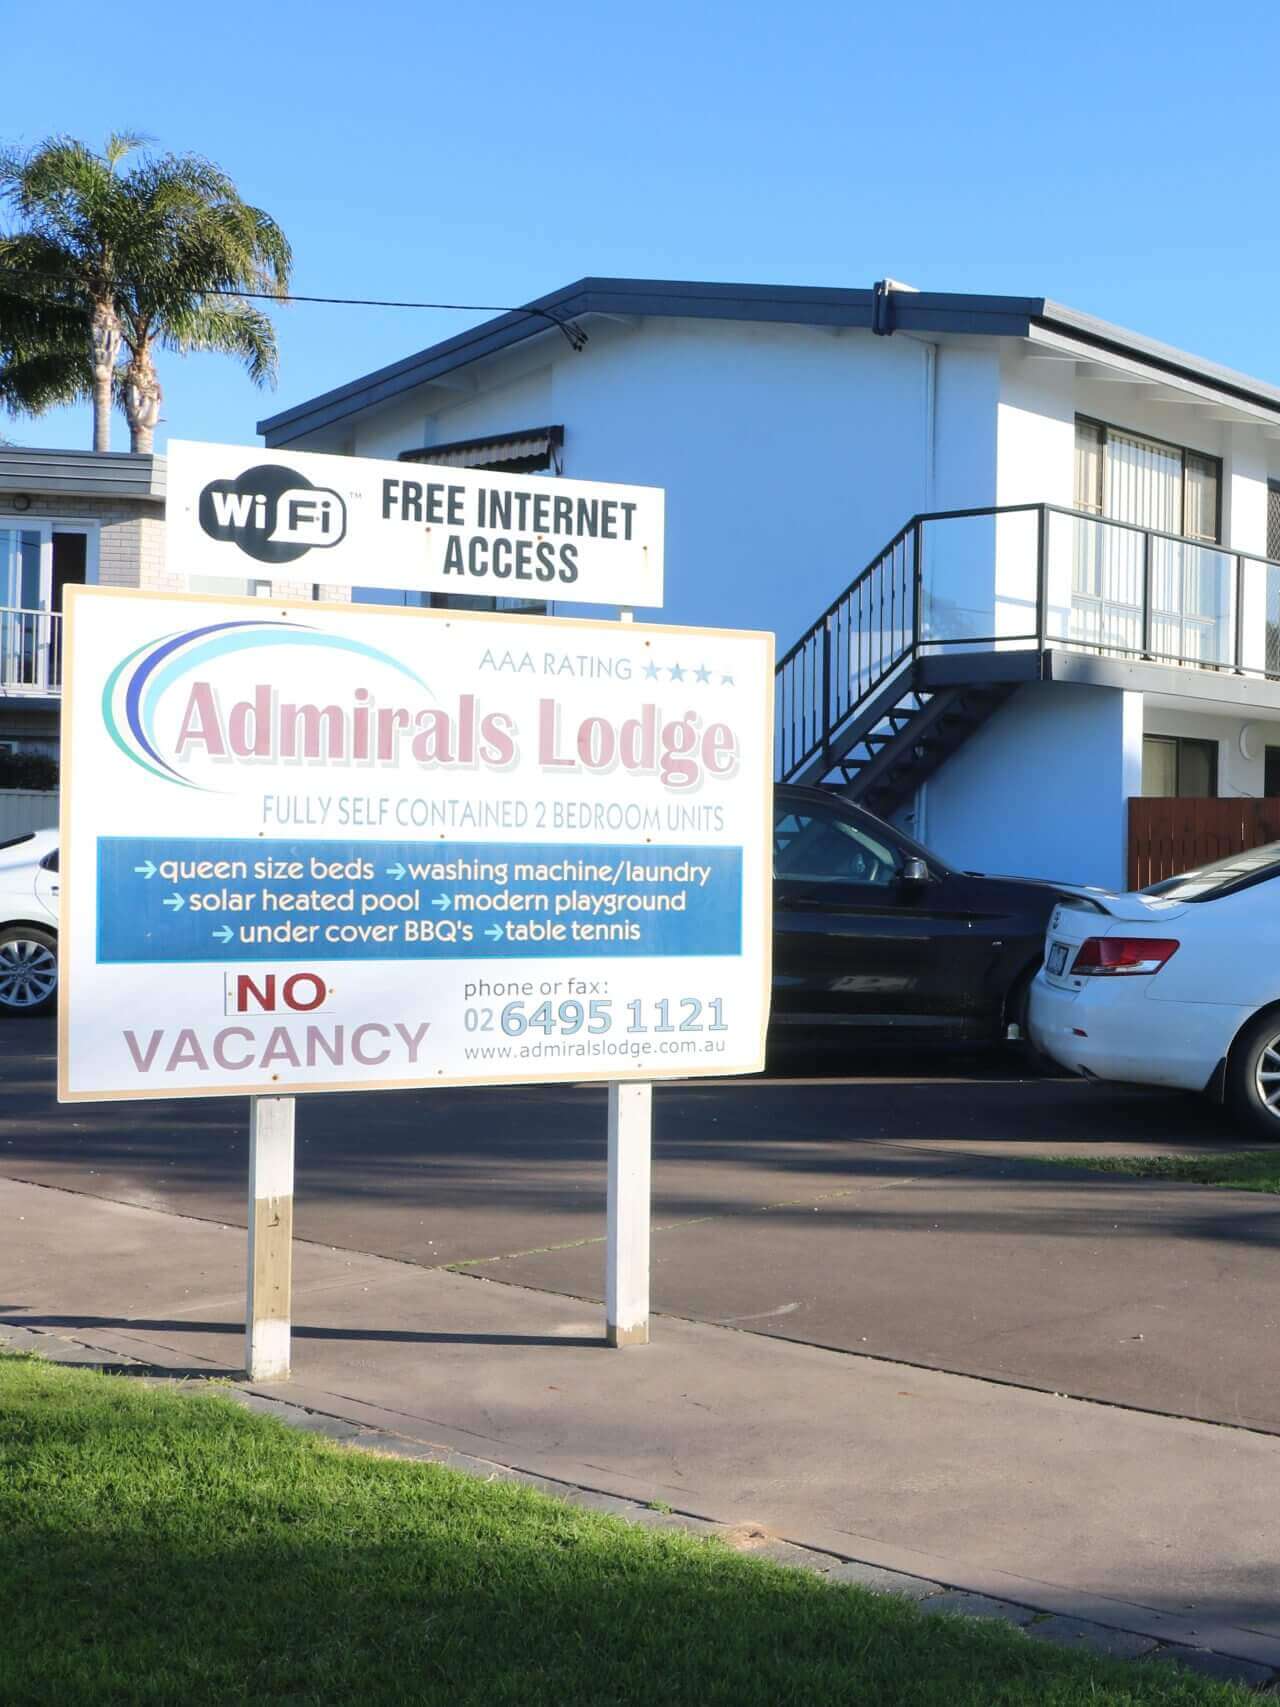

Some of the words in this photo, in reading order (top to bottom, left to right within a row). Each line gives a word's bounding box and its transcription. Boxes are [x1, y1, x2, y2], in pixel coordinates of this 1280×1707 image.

[382, 478, 466, 527] FREE
[478, 488, 637, 541] INTERNET
[443, 535, 579, 584] ACCESS
[478, 648, 536, 673] AAA
[543, 653, 632, 680] RATING
[174, 681, 518, 770] Admirals
[538, 698, 738, 790] Lodge
[263, 794, 332, 825] FULLY
[338, 796, 390, 826] SELF
[395, 798, 529, 828] CONTAINED
[535, 801, 547, 828] 2
[553, 801, 661, 830] BEDROOM
[667, 804, 724, 832] UNITS
[159, 860, 247, 883] queen
[253, 857, 304, 880] size
[310, 857, 375, 880] beds
[408, 859, 508, 884] washing
[514, 860, 711, 886] machine/laundry
[188, 888, 256, 912] solar
[262, 888, 354, 912] heated
[361, 889, 420, 915] pool
[453, 889, 548, 911] modern
[555, 889, 687, 915] playground
[240, 920, 320, 943] under
[326, 923, 399, 943] cover
[404, 920, 474, 943] BBQ's
[505, 920, 567, 942] table
[571, 920, 641, 941] tennis
[236, 972, 327, 1013] NO
[464, 979, 534, 1001] phone
[539, 980, 563, 995] or
[567, 977, 609, 995] fax:
[463, 1008, 495, 1032] 02
[500, 999, 613, 1037] 6495
[626, 997, 729, 1033] 1121
[122, 1022, 431, 1073] VACANCY
[464, 1038, 726, 1060] www.admiralslodge.com.au
